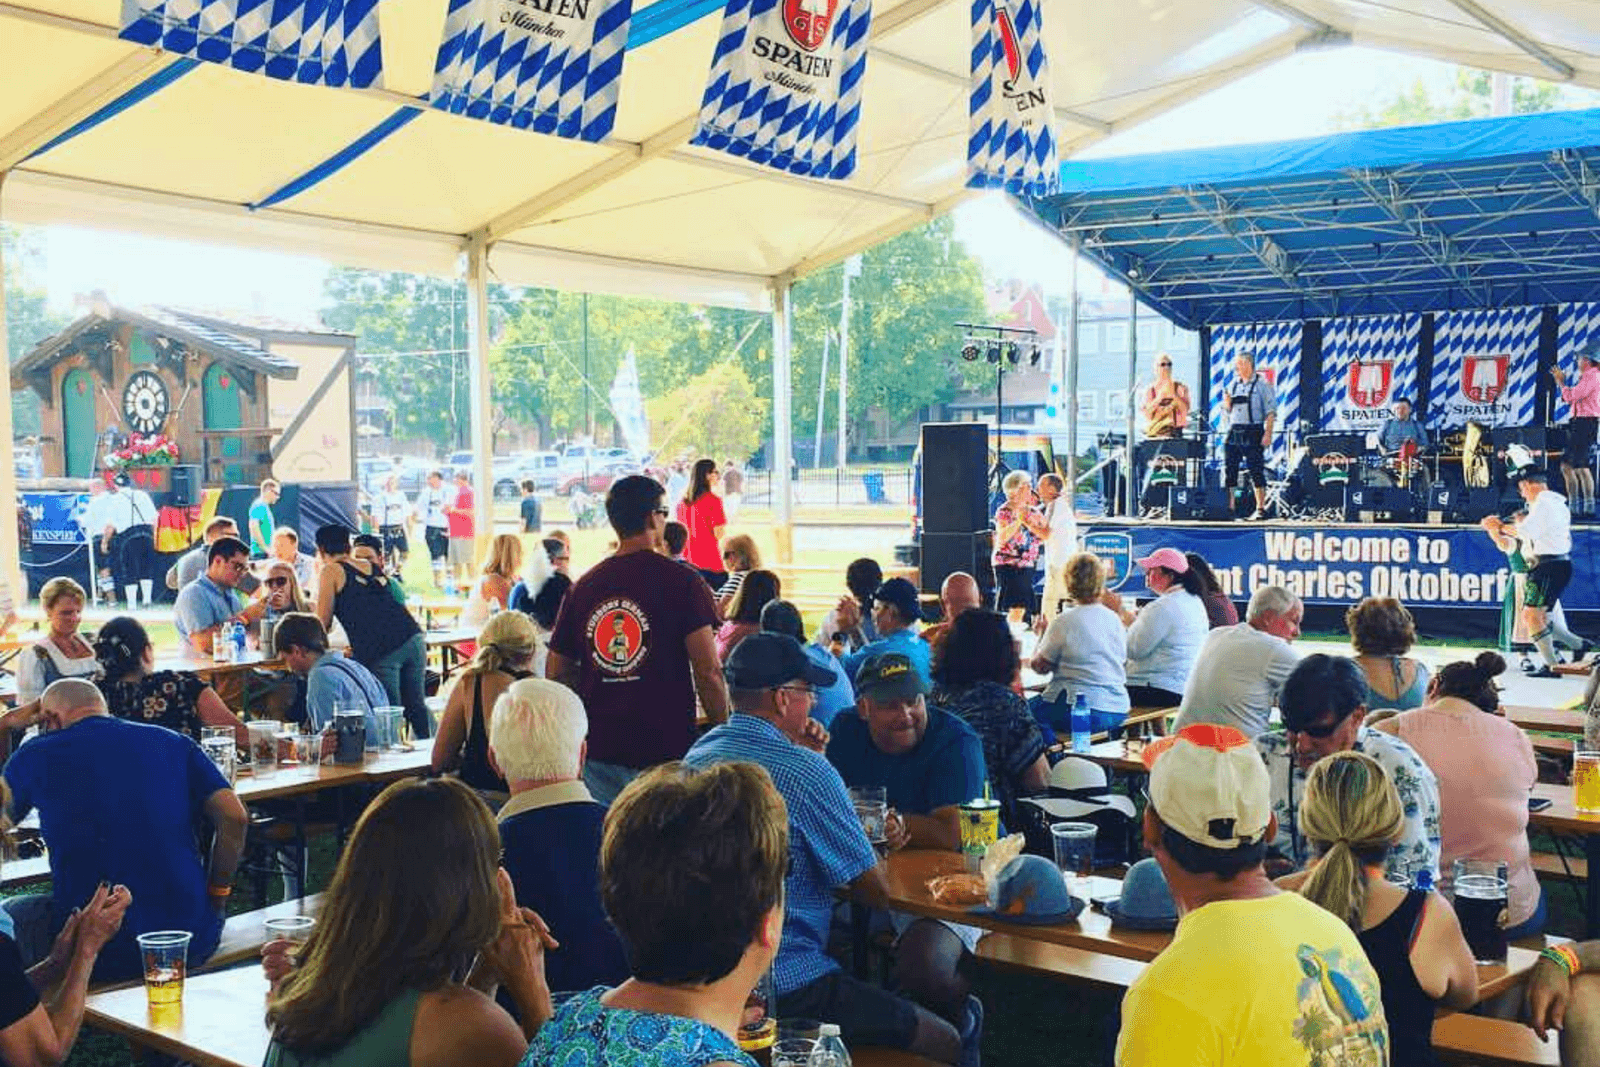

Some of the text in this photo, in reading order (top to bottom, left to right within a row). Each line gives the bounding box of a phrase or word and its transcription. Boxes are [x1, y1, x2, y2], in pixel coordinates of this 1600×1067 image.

[752, 36, 833, 78] SPATEN
[1341, 408, 1397, 420] SPATEN
[1264, 531, 1450, 564] Welcome to
[1248, 562, 1364, 600] Charles
[1370, 565, 1509, 603] Oktoberf
